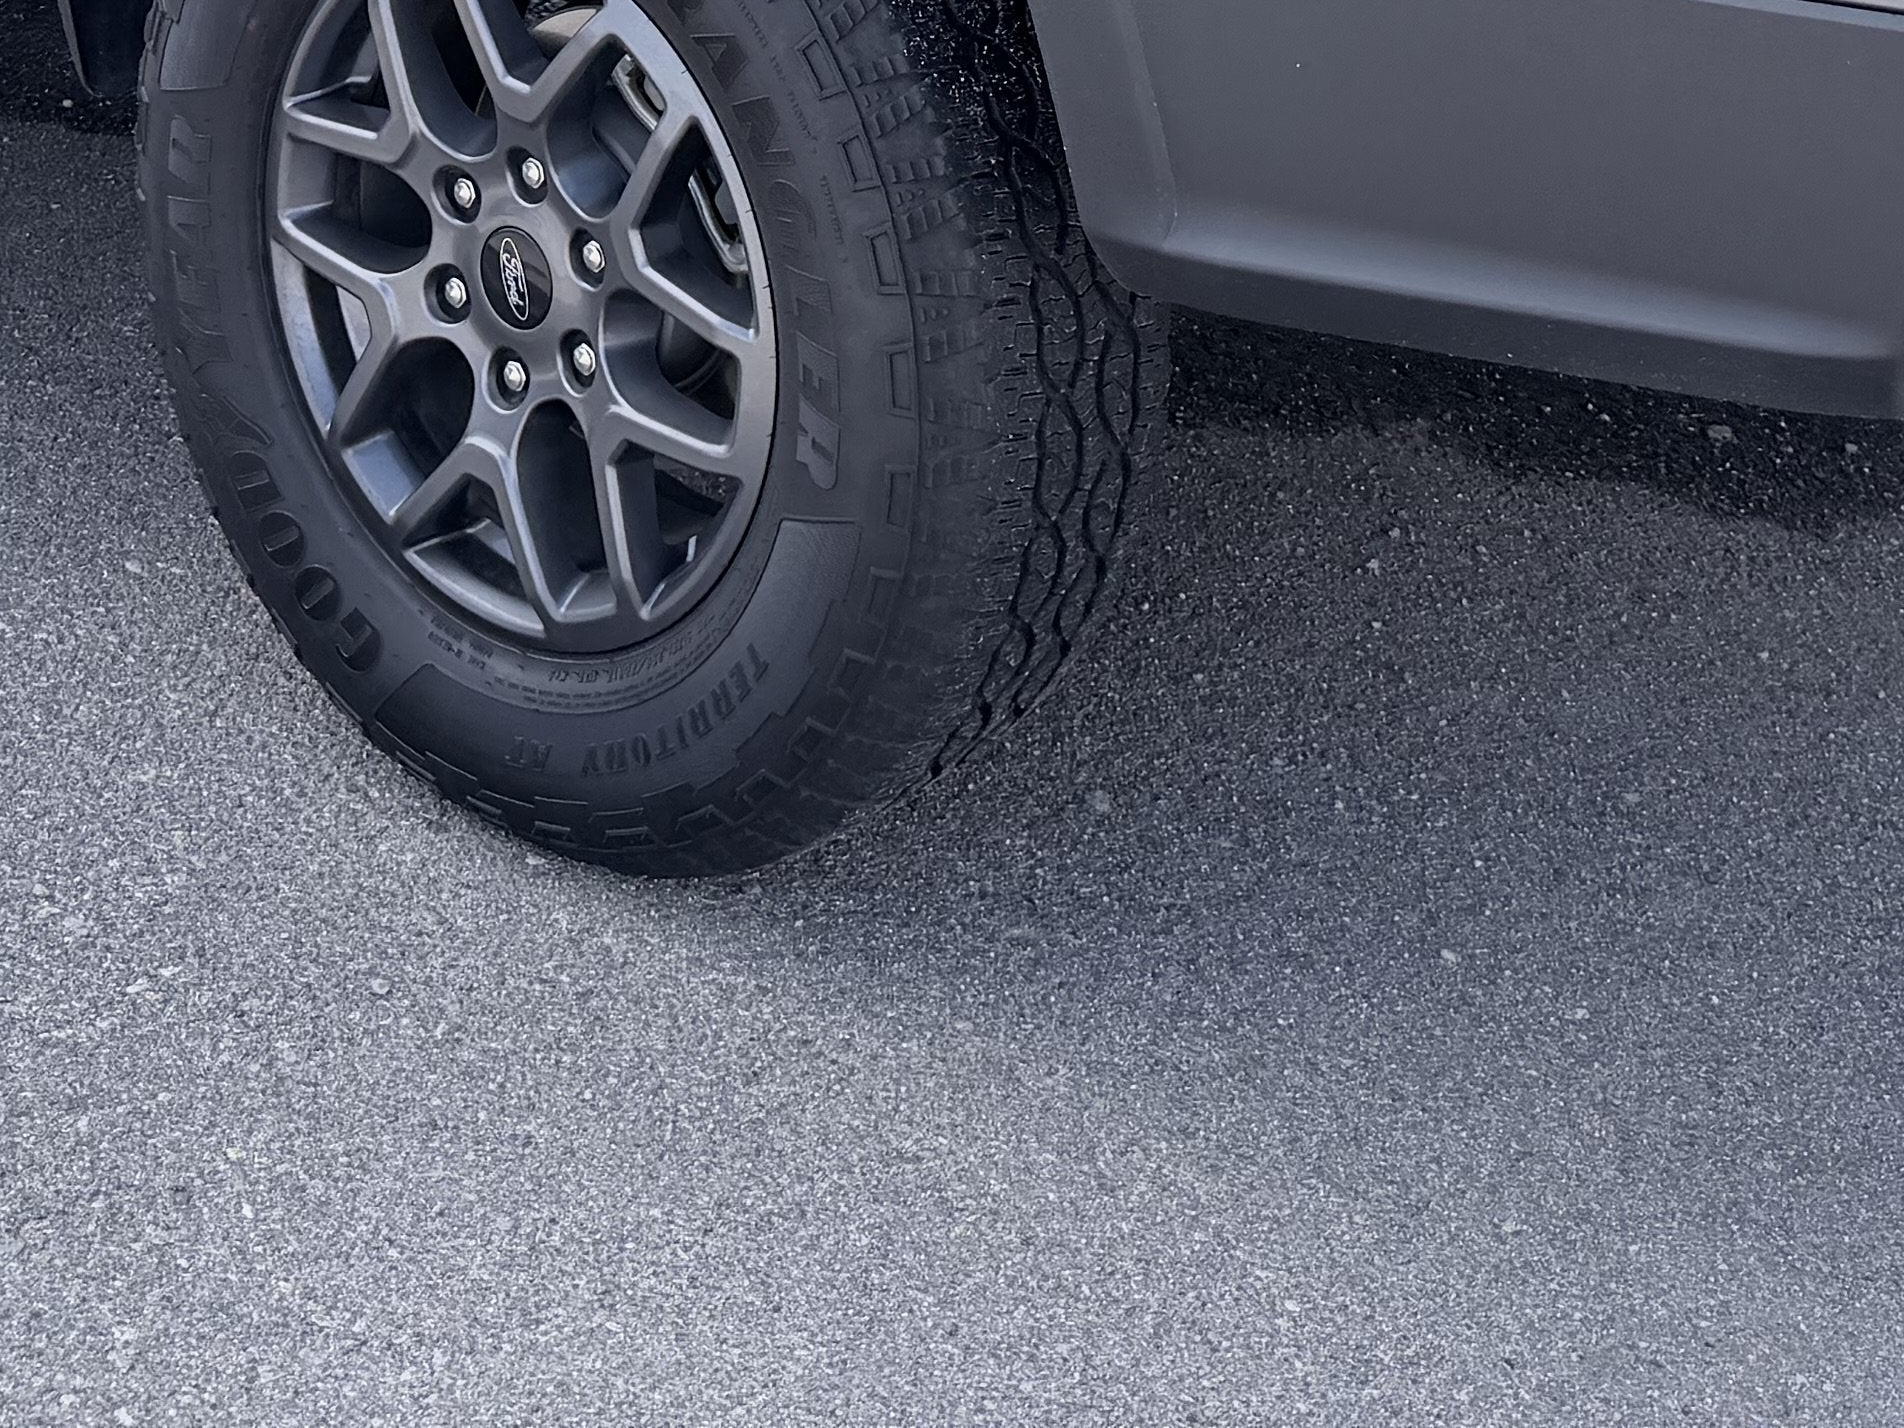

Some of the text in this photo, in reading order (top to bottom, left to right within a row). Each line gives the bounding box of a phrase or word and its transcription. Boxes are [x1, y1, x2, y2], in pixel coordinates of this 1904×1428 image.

[502, 251, 526, 308] Ford
[167, 114, 381, 673] GOODYEAR
[581, 642, 771, 777] TERRITORY
